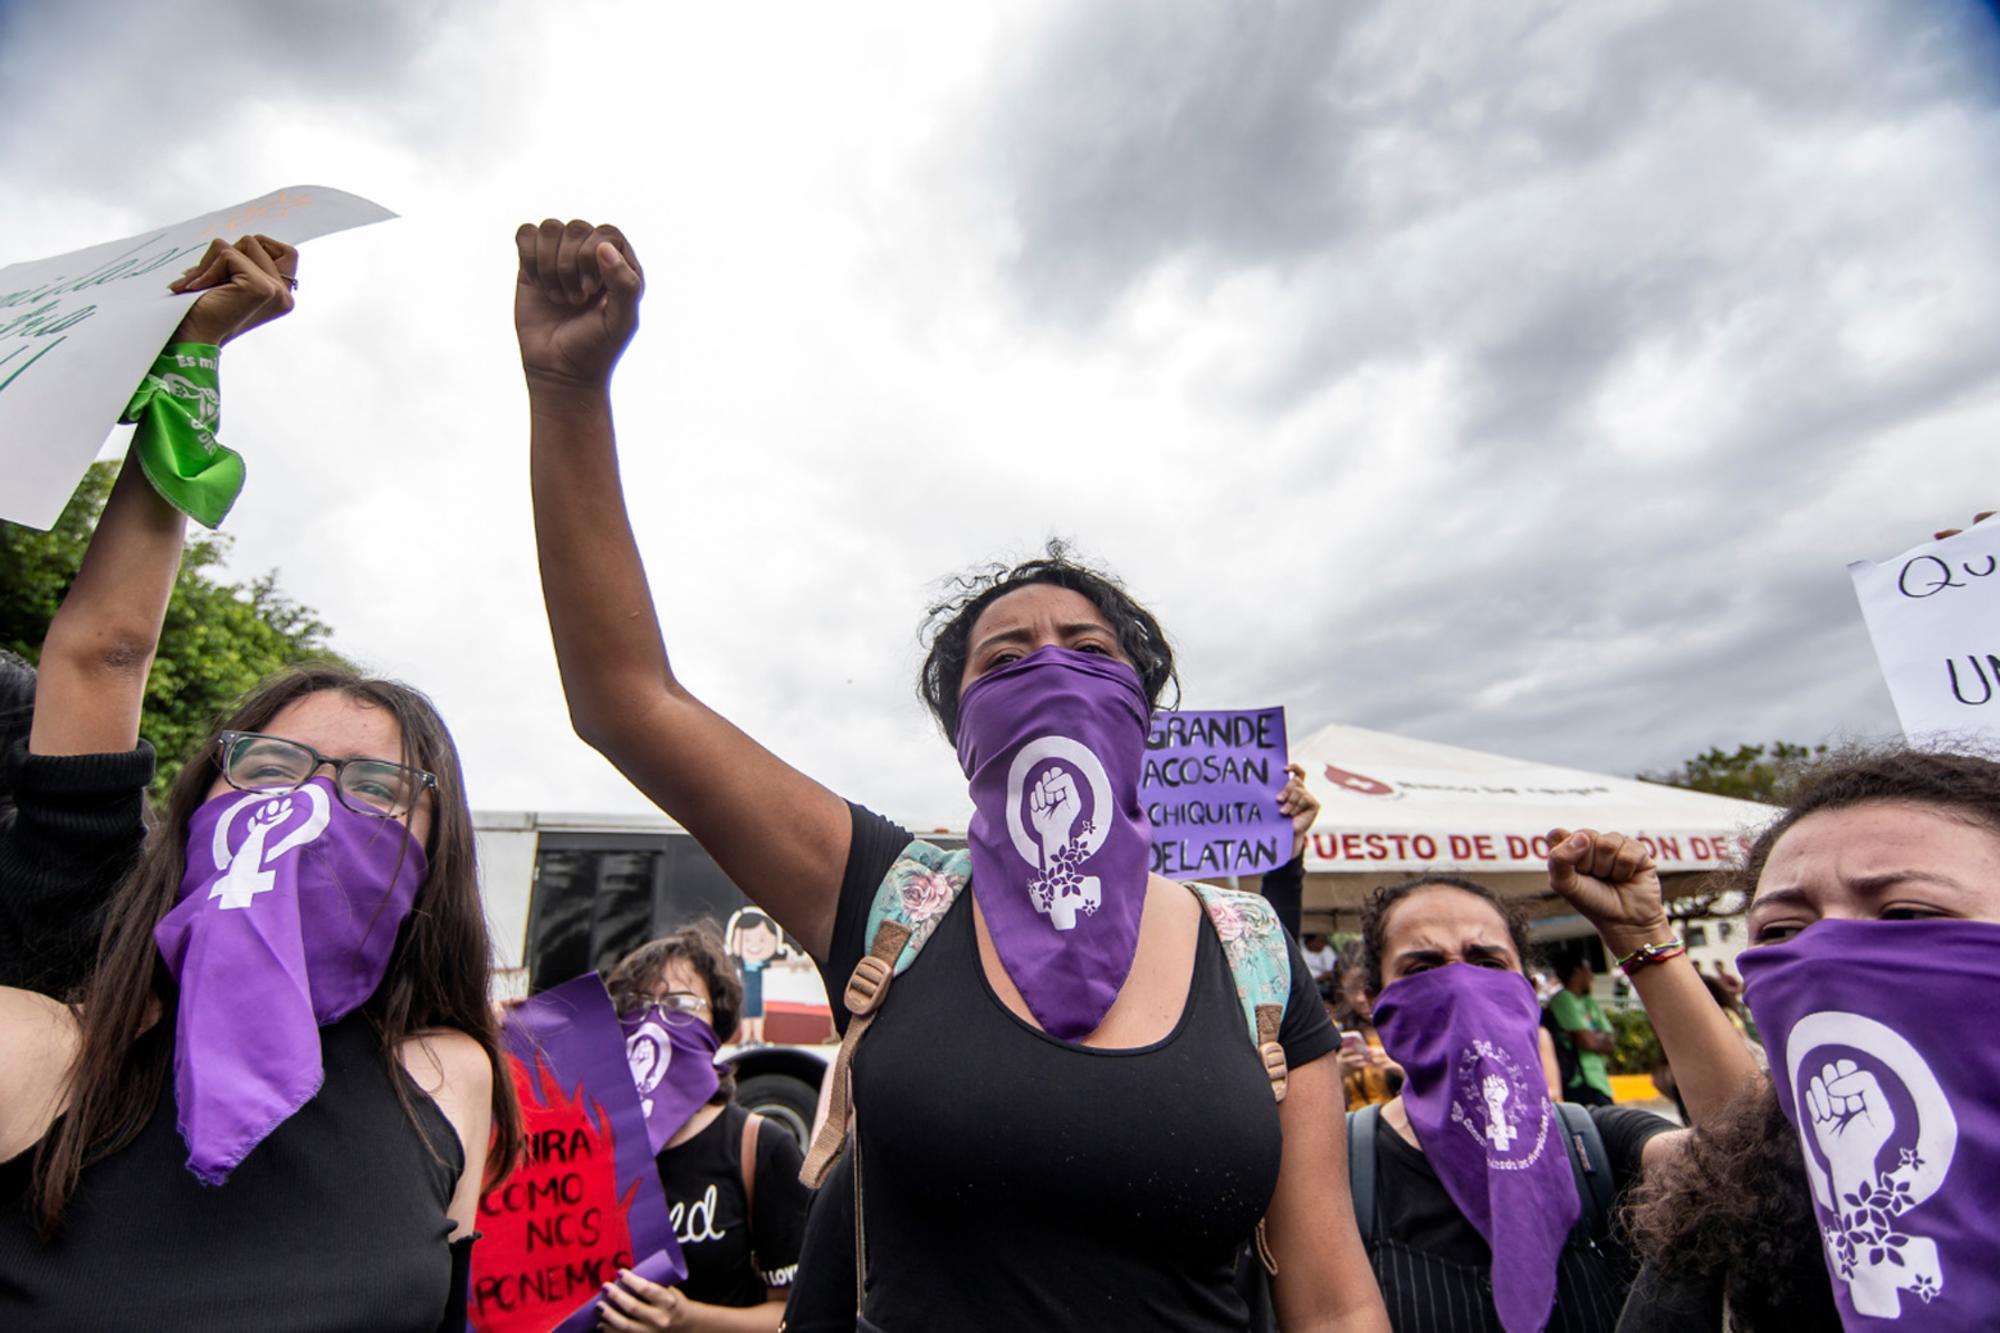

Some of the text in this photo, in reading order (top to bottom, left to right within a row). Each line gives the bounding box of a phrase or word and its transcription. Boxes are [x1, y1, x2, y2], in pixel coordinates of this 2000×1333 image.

[176, 354, 196, 369] Es
[1147, 713, 1276, 750] GRANDE
[1143, 756, 1269, 789] ACOSAN
[1149, 801, 1263, 827] CHIQUITA
[1151, 836, 1277, 874] DELATAN
[1302, 833, 1438, 861] UESTO
[1448, 834, 1498, 861] DE
[1689, 836, 1729, 861] DE
[479, 1173, 584, 1217] COMO
[526, 1207, 602, 1254] NOS
[769, 1263, 800, 1287] LOV
